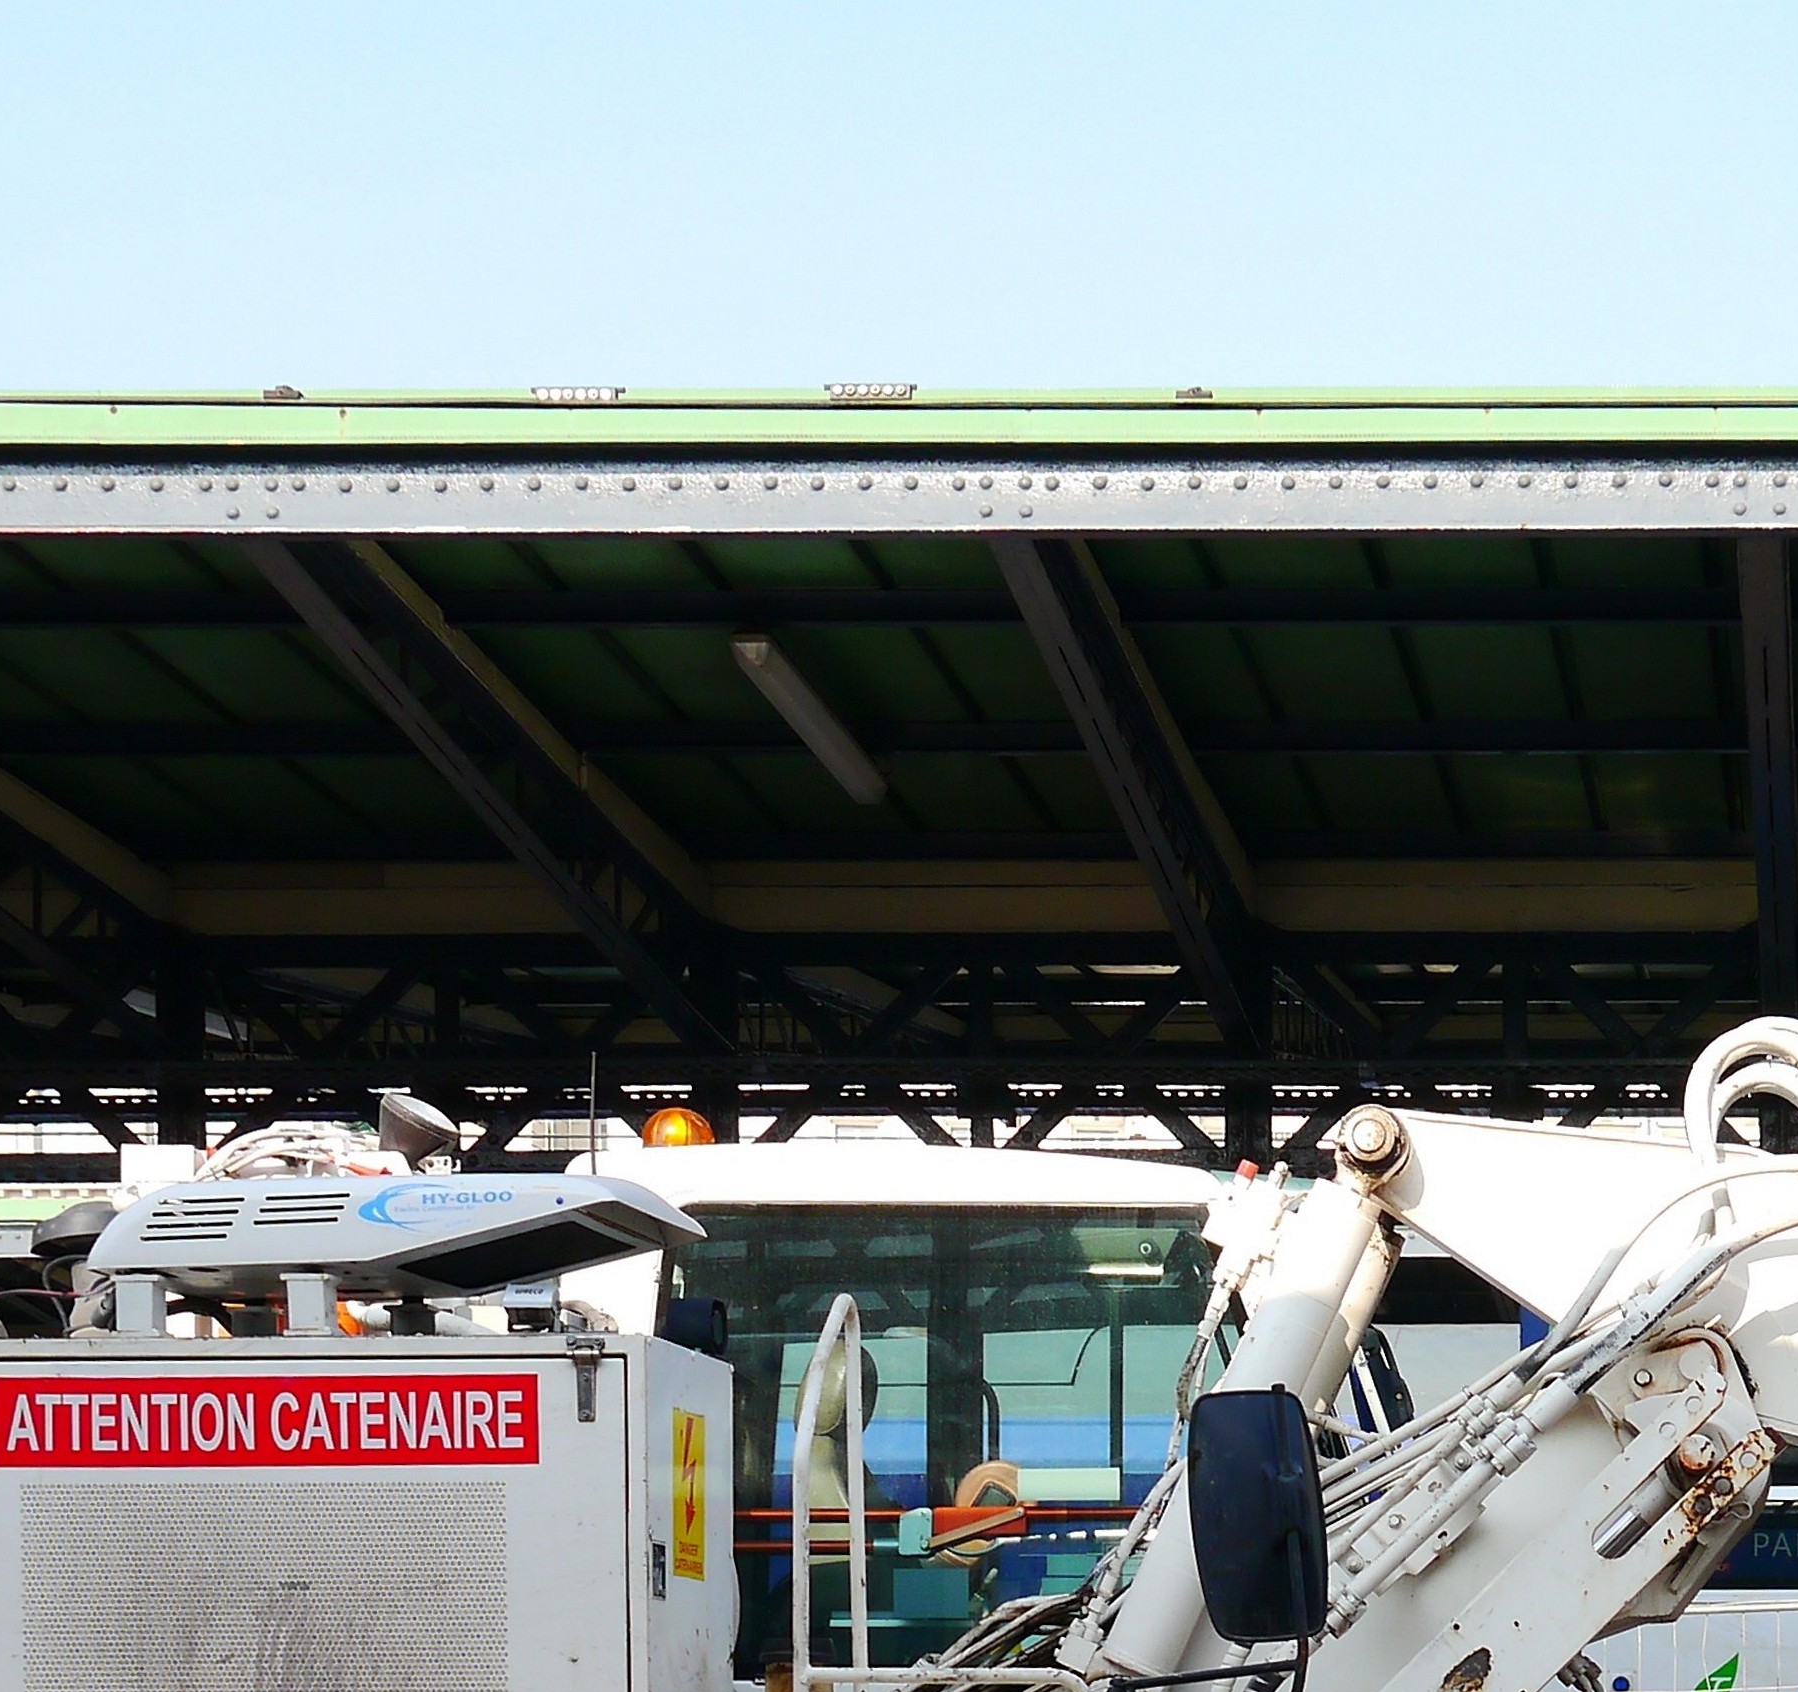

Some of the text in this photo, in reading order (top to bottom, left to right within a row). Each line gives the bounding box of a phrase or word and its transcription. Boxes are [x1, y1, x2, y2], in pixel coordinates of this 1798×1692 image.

[421, 1190, 513, 1205] HY-GLOO
[5, 1390, 525, 1453] ATTENTION CATENAIRE
